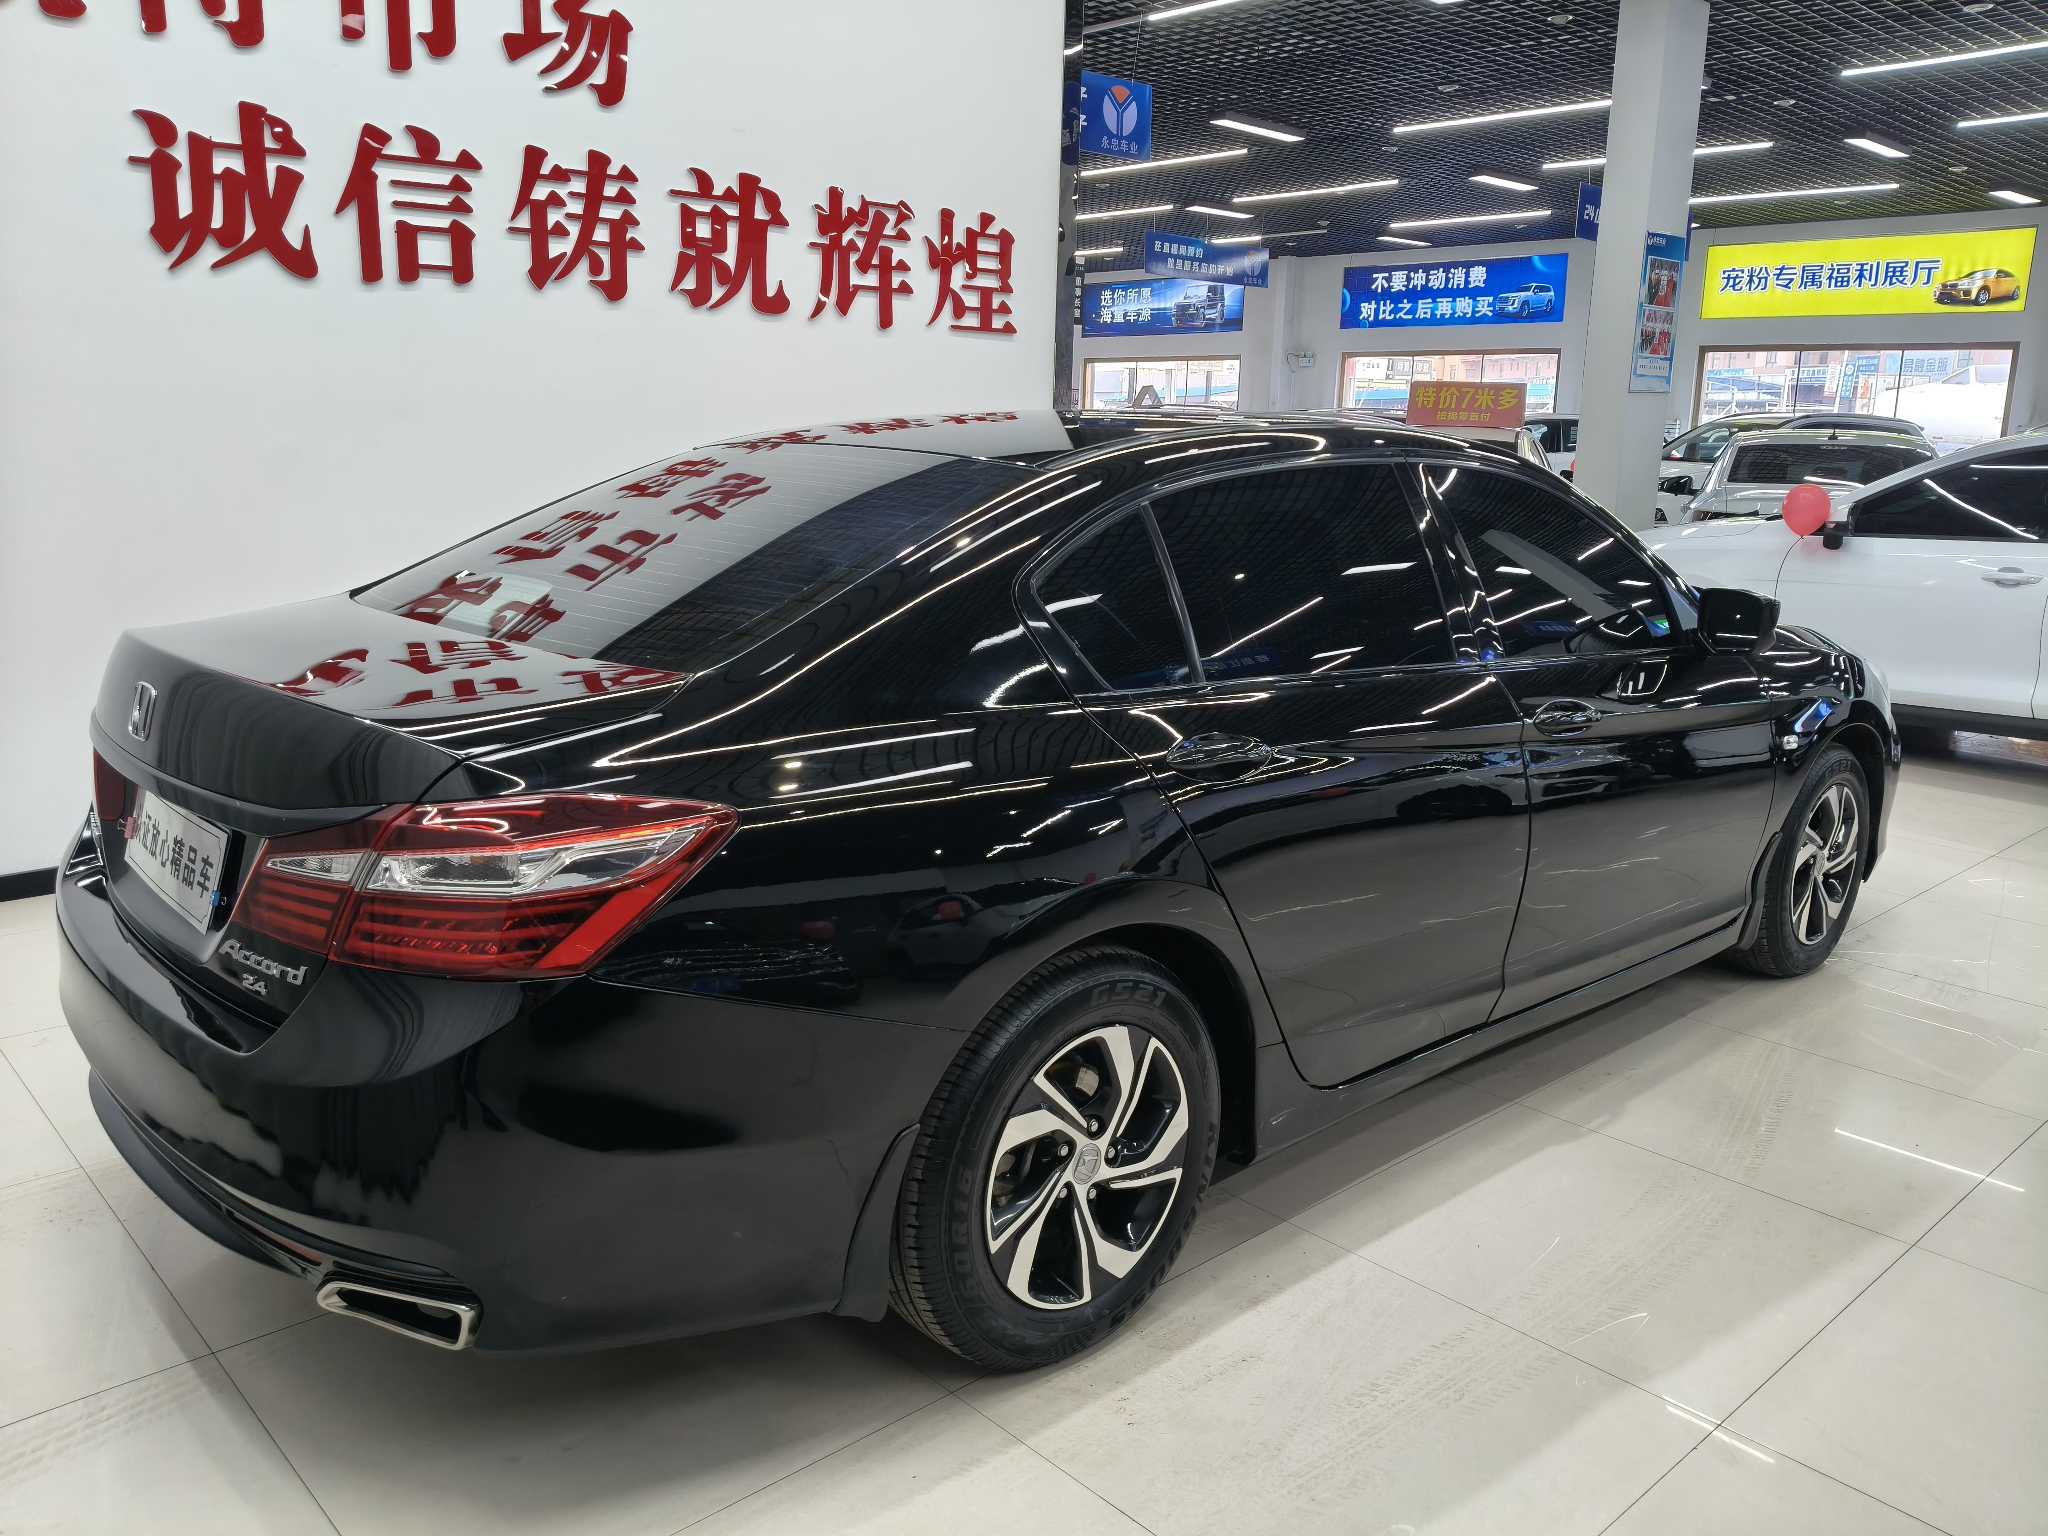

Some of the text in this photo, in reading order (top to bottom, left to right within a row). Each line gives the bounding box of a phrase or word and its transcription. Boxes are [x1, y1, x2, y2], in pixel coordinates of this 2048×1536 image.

[128, 101, 1017, 334] 诚信铸就辉煌
[1371, 265, 1488, 292] 不要冲动消费
[1719, 259, 1942, 293] 宠粉专属福利展厅
[1100, 287, 1152, 306] 选你所愿
[1359, 296, 1495, 321] 对比之后再购买
[1100, 305, 1152, 323] 海量车源
[1415, 386, 1521, 410] 特价7米多
[218, 938, 309, 986] Accord
